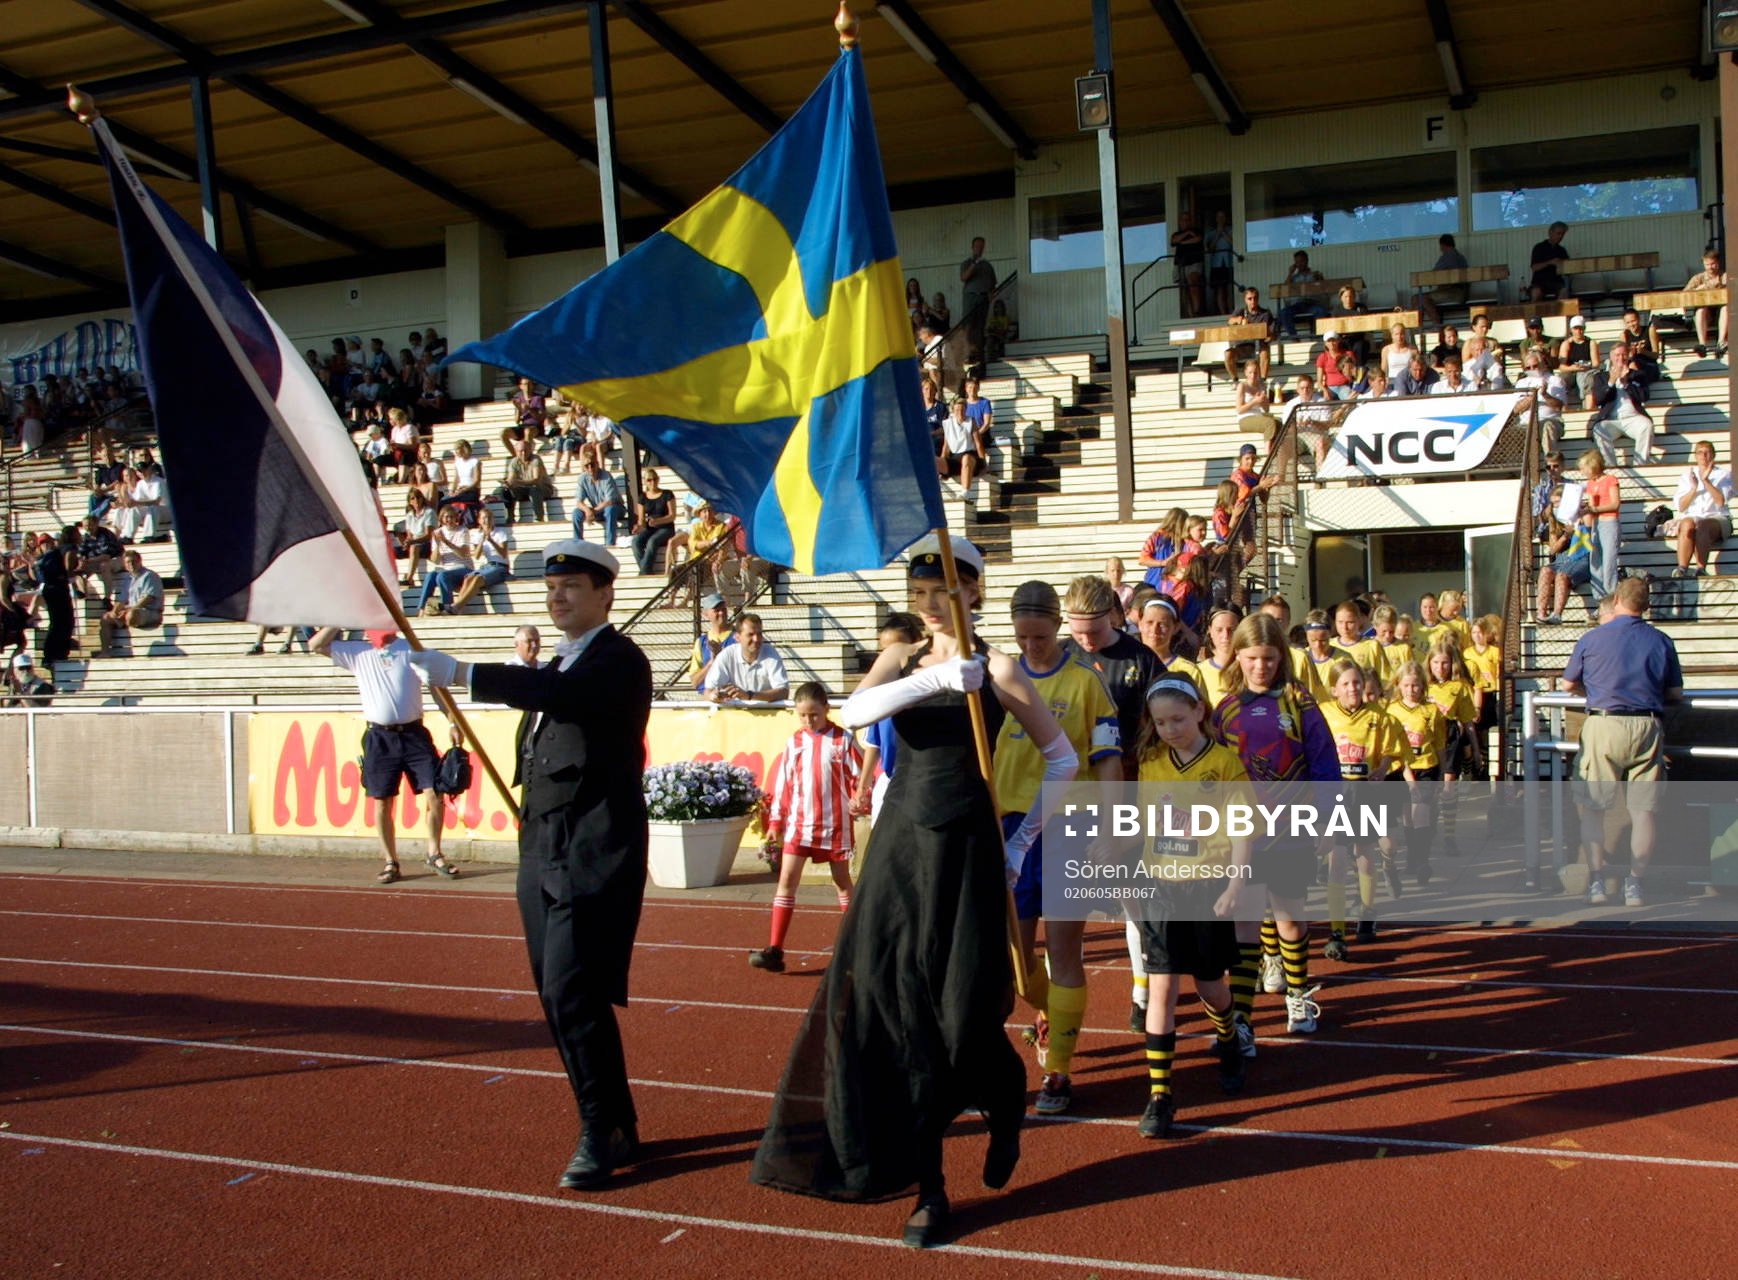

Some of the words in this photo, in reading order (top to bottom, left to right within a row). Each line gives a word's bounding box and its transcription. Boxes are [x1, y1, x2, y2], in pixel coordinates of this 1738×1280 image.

[1427, 116, 1444, 141] F
[351, 290, 359, 300] D
[1346, 429, 1455, 466] NCC
[1157, 839, 1189, 852] gol.nu
